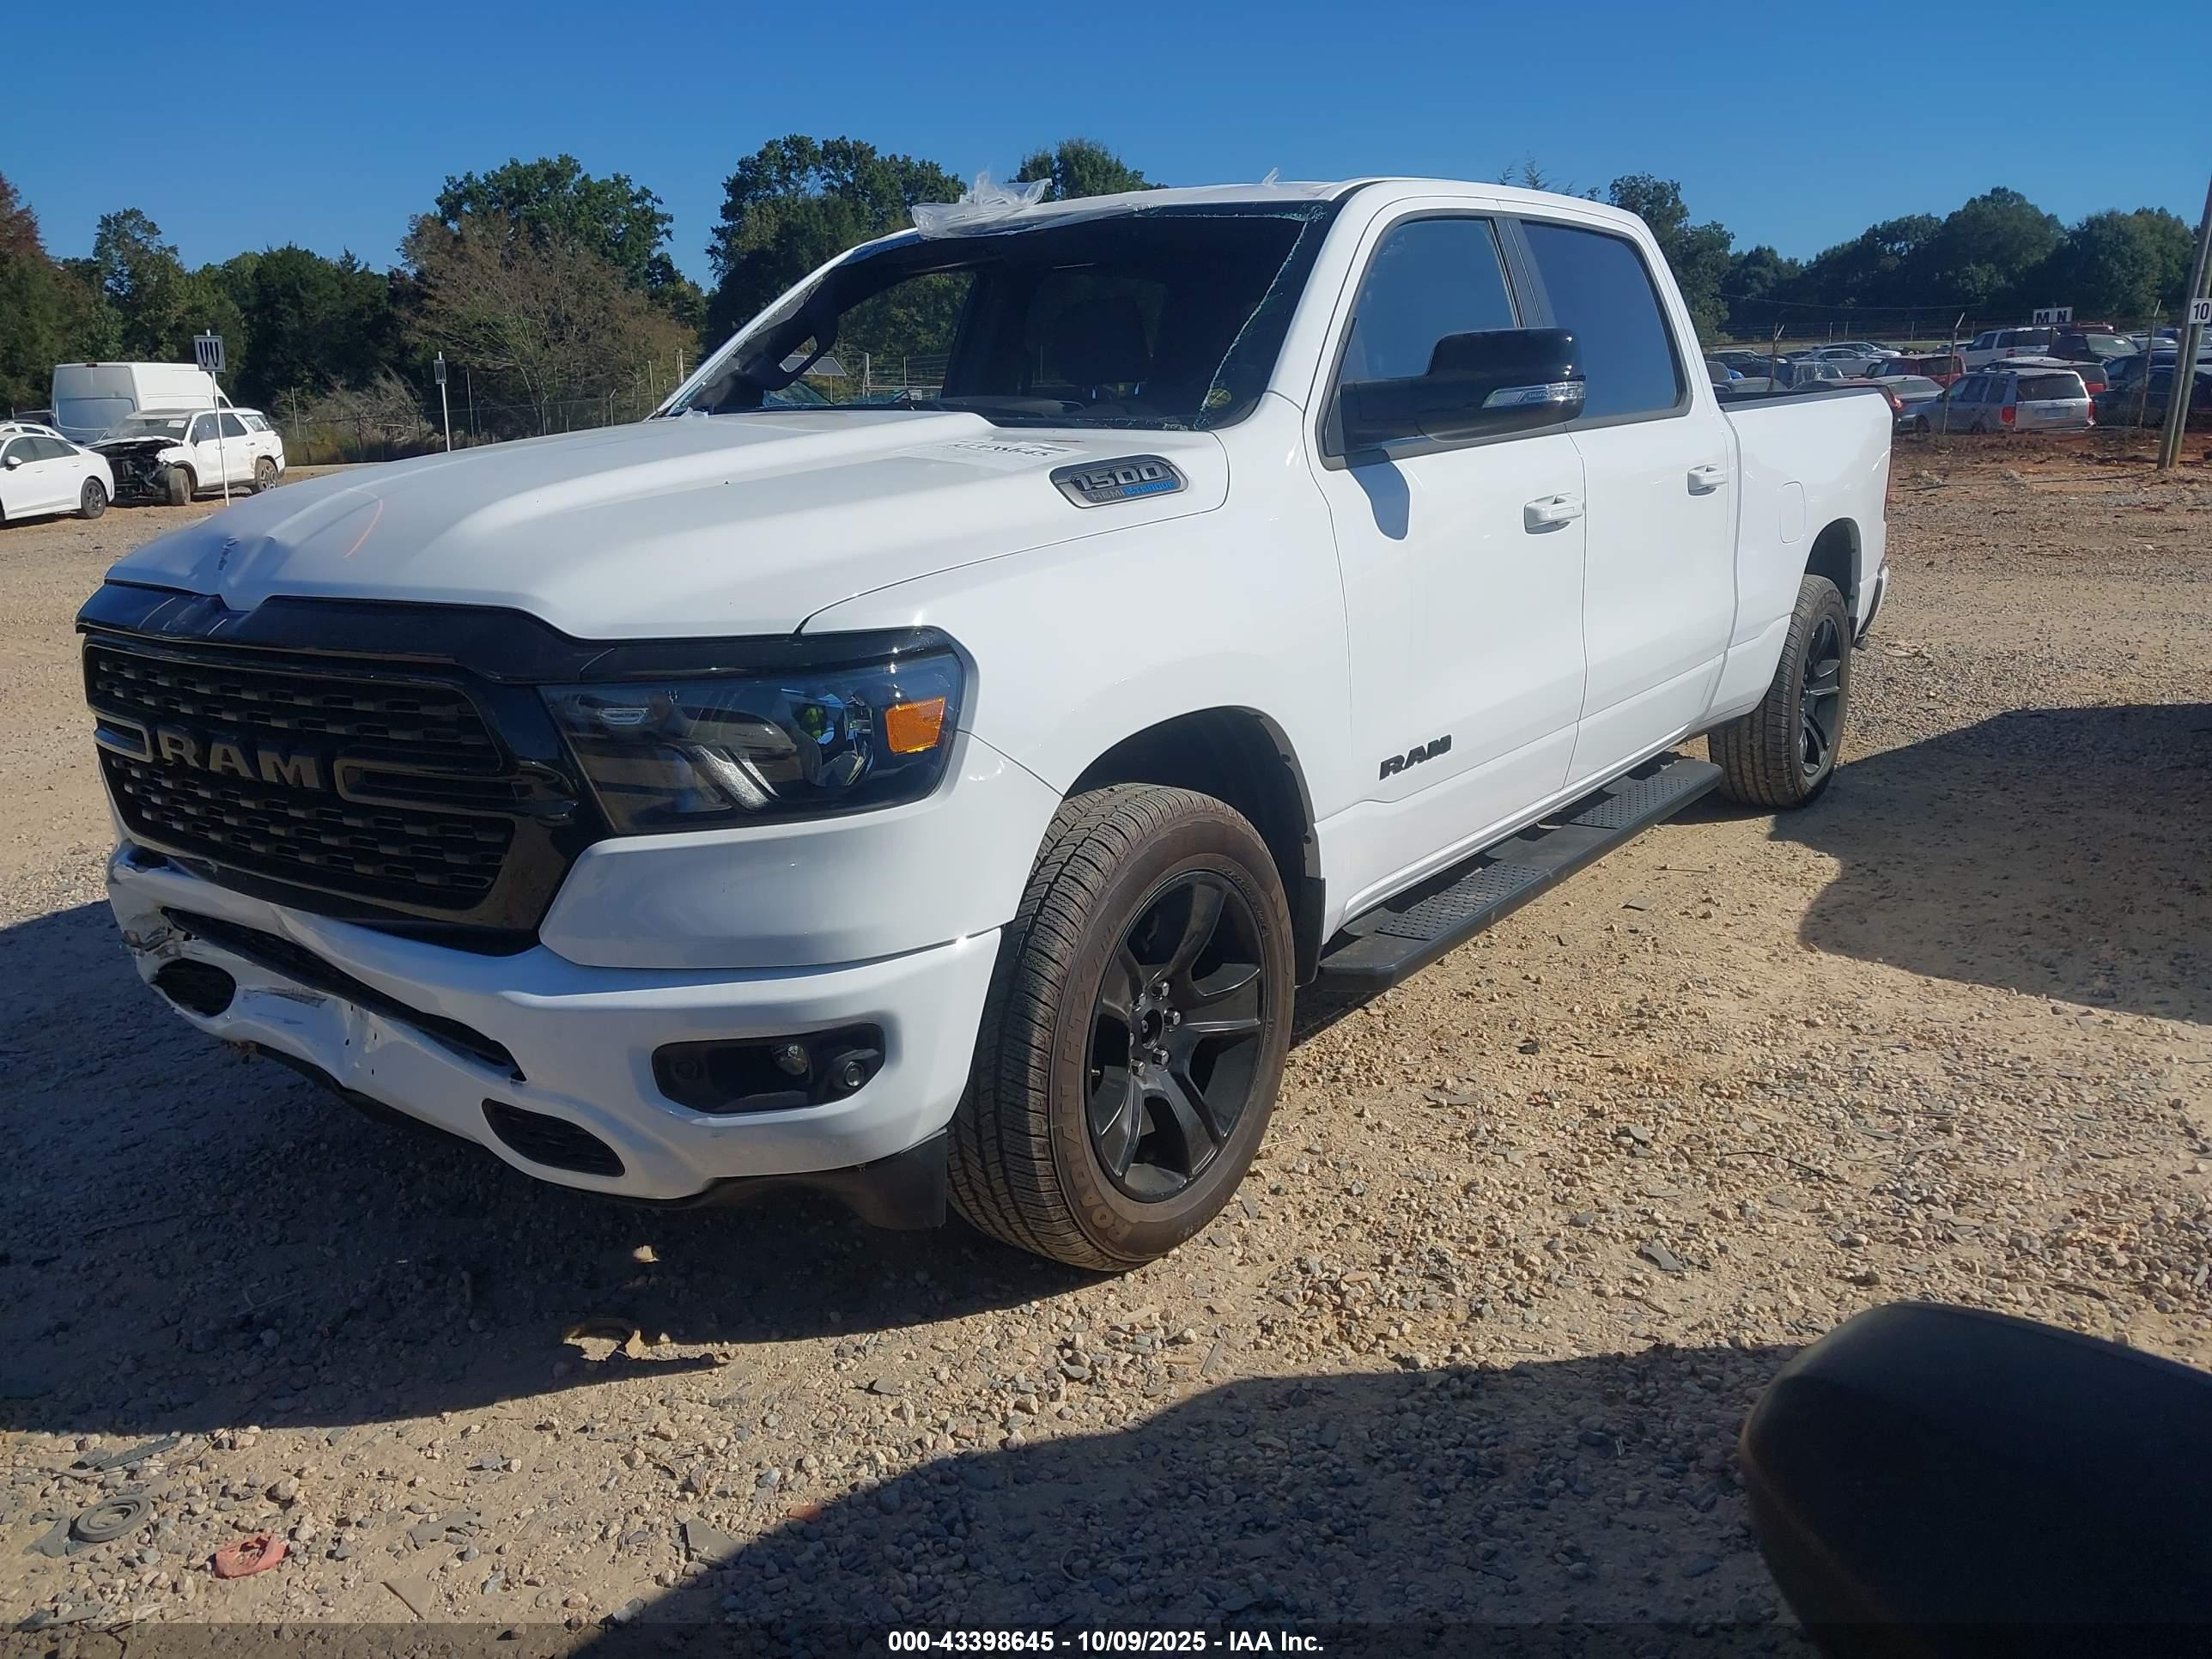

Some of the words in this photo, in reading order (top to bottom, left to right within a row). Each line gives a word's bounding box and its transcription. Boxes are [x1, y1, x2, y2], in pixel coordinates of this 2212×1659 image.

[2036, 311, 2050, 324] M
[2057, 310, 2068, 322] N
[2193, 302, 2210, 320] 10
[1073, 465, 1164, 491] 1500
[156, 730, 321, 789] RAM
[1378, 734, 1452, 781] RAM
